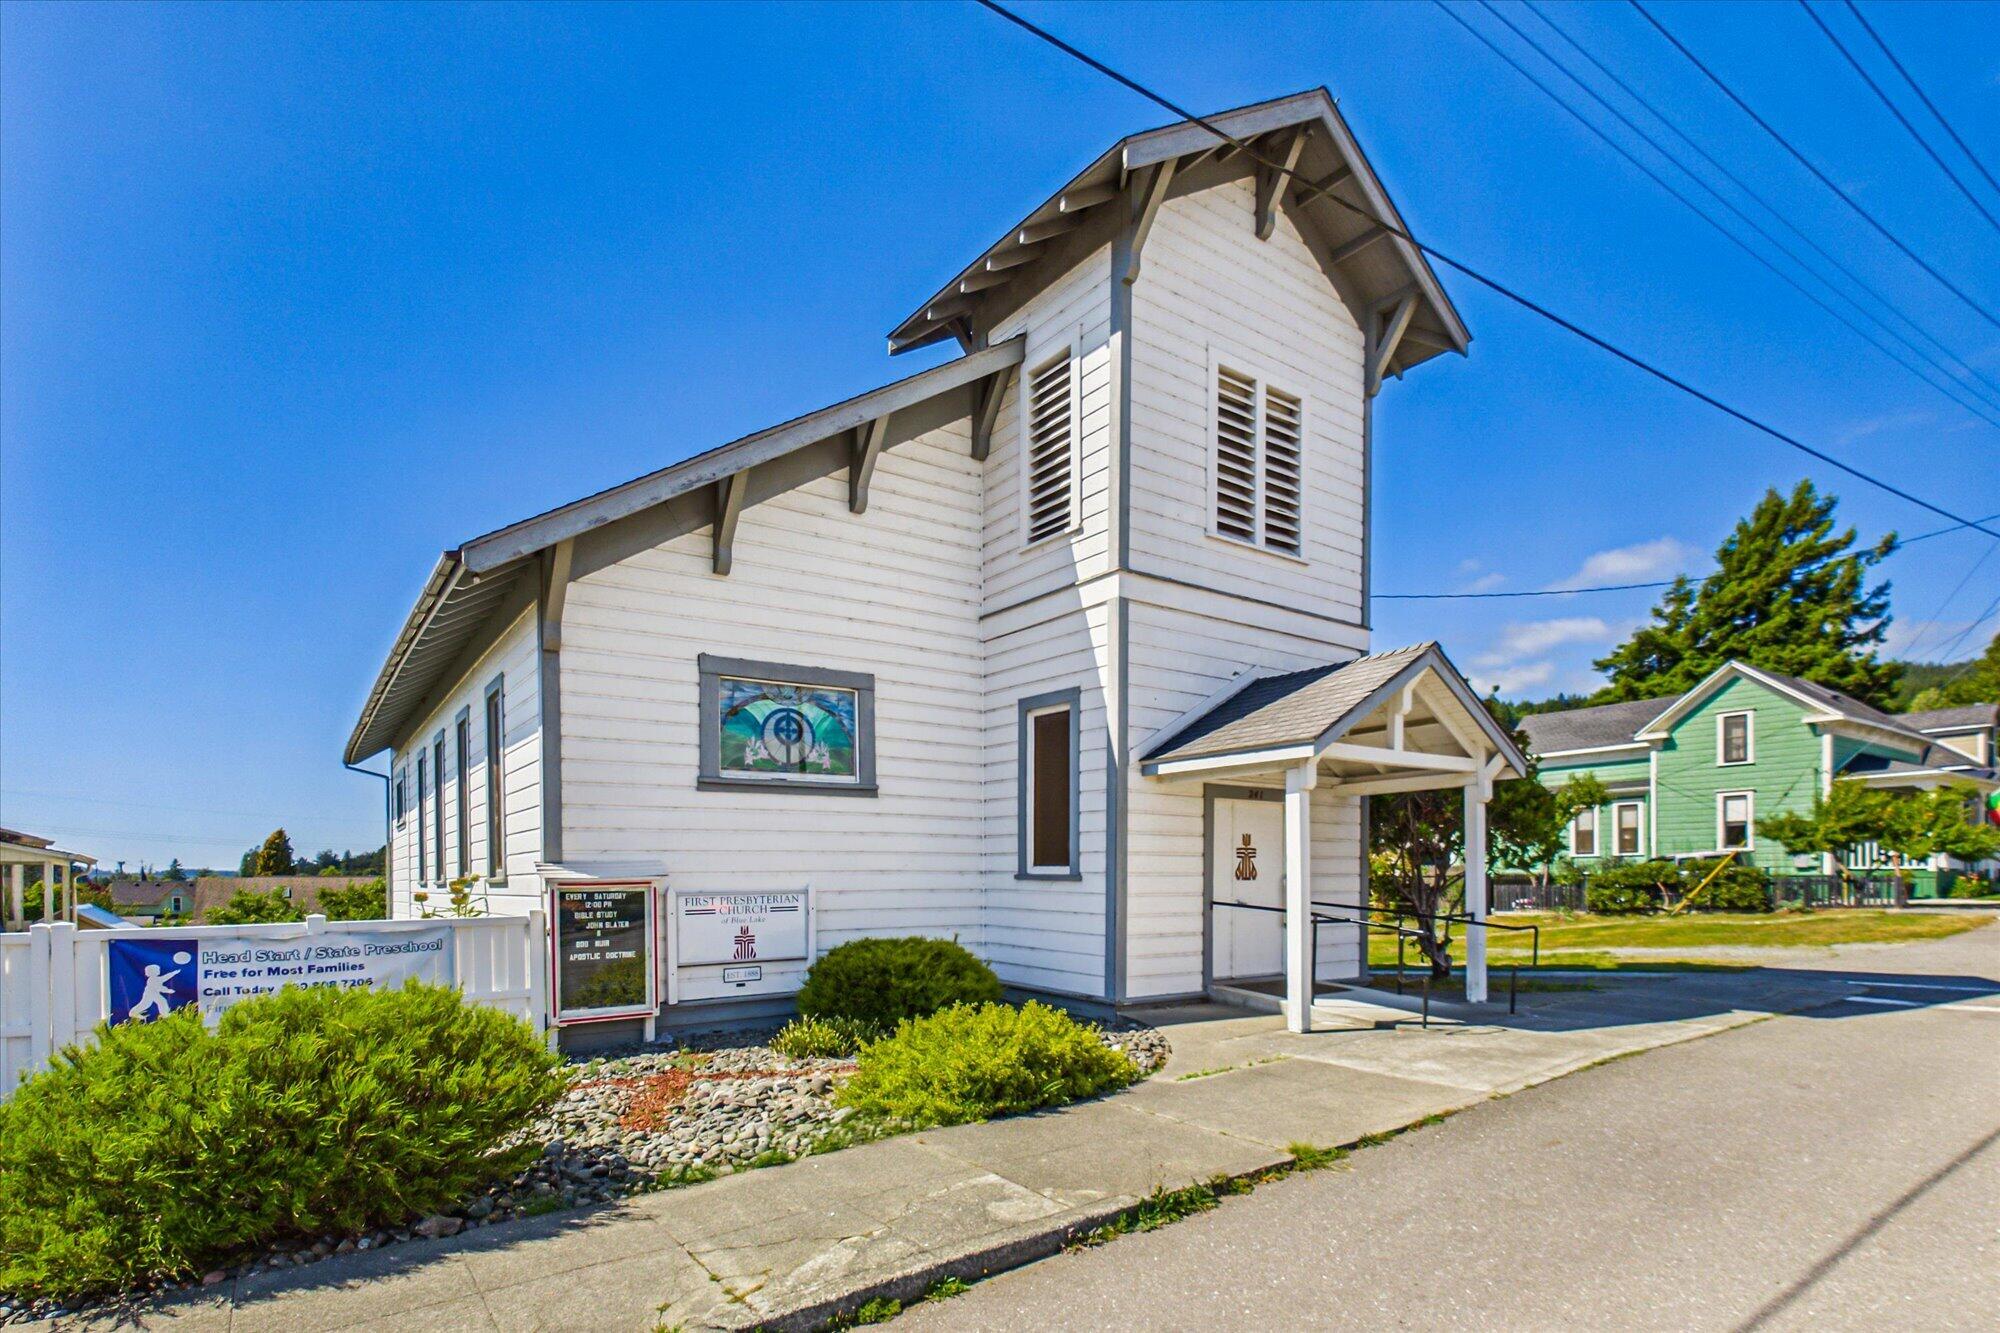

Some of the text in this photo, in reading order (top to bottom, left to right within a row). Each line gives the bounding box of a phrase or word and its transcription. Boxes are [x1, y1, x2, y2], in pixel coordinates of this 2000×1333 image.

[594, 892, 627, 900] SATURDAY
[685, 895, 799, 907] FIRST PRESBYTERIAN
[719, 905, 768, 916] CHURCH
[574, 911, 618, 920] BIBLE STUDY
[586, 921, 630, 930] JOHN SLATER
[202, 938, 443, 964] Head Start / State Preschool
[605, 950, 637, 959] DOCTRINE
[204, 962, 365, 979] Free for Most Families
[203, 987, 230, 996] Call
